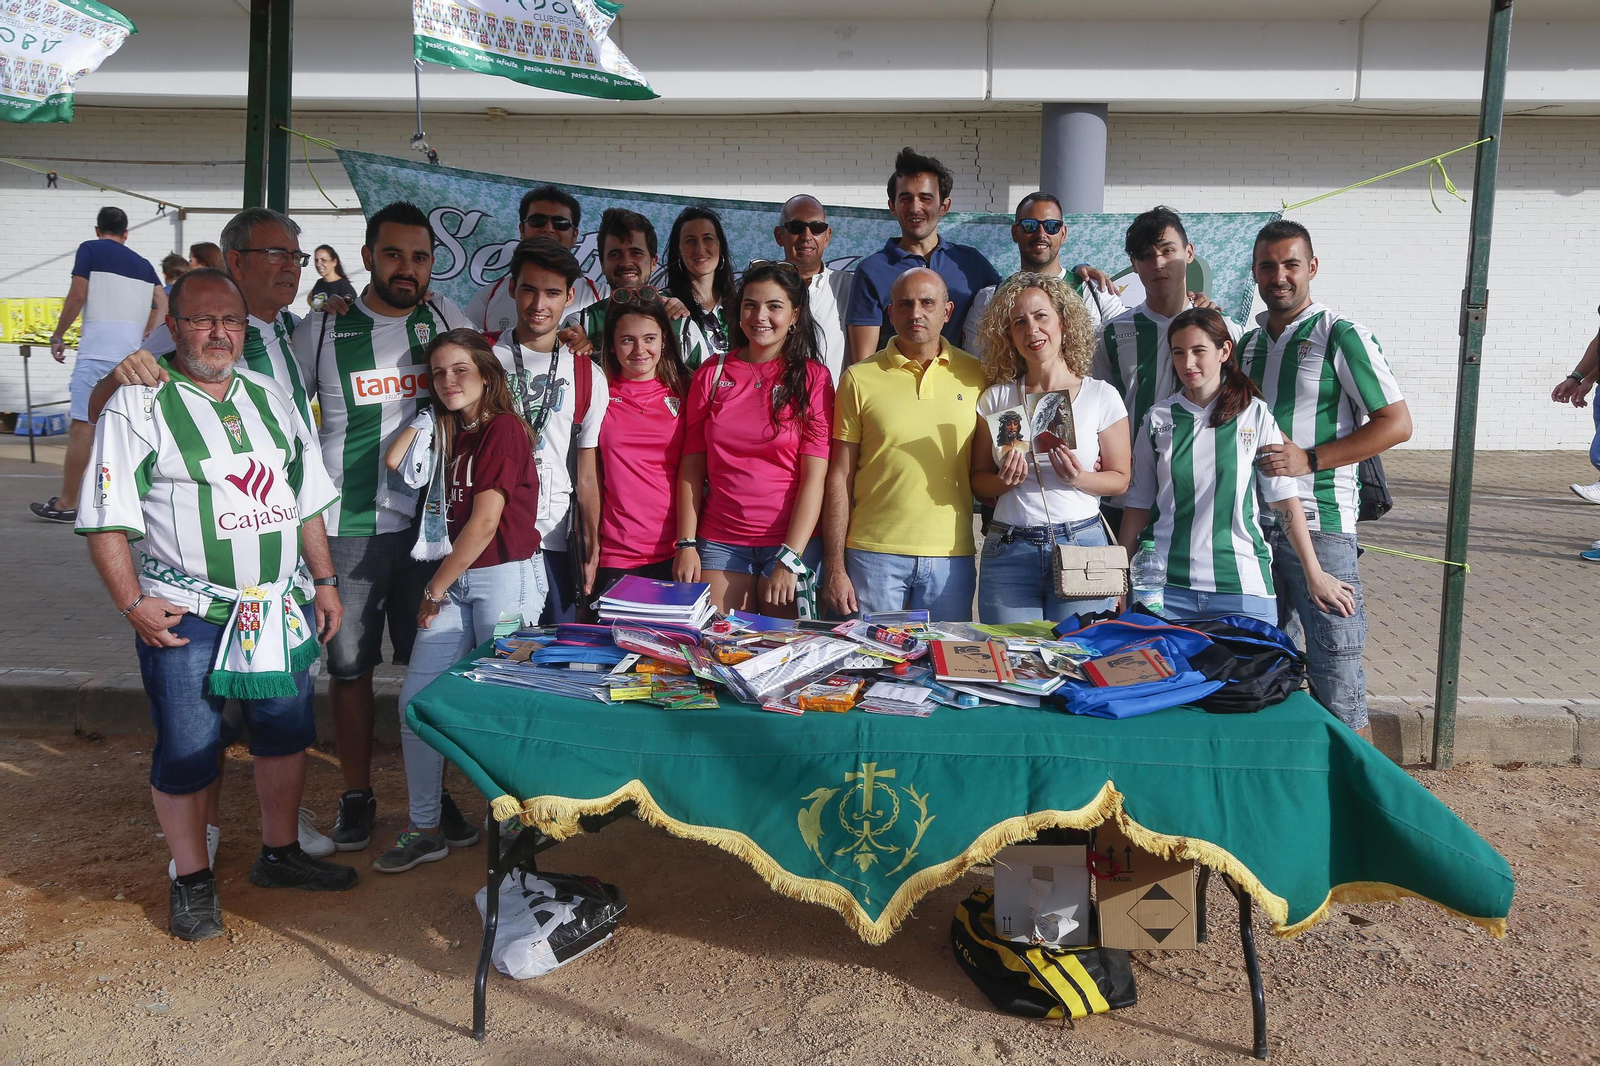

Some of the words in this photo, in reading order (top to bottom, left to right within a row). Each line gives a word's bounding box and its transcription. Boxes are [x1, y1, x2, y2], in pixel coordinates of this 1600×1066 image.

[425, 40, 445, 52] pasión
[447, 46, 470, 58] infinita
[496, 57, 518, 69] infinita
[523, 64, 543, 74] pasión
[544, 66, 566, 77] infinita
[571, 71, 590, 80] pasión
[590, 73, 609, 84] infinita
[218, 505, 298, 531] CajaSur
